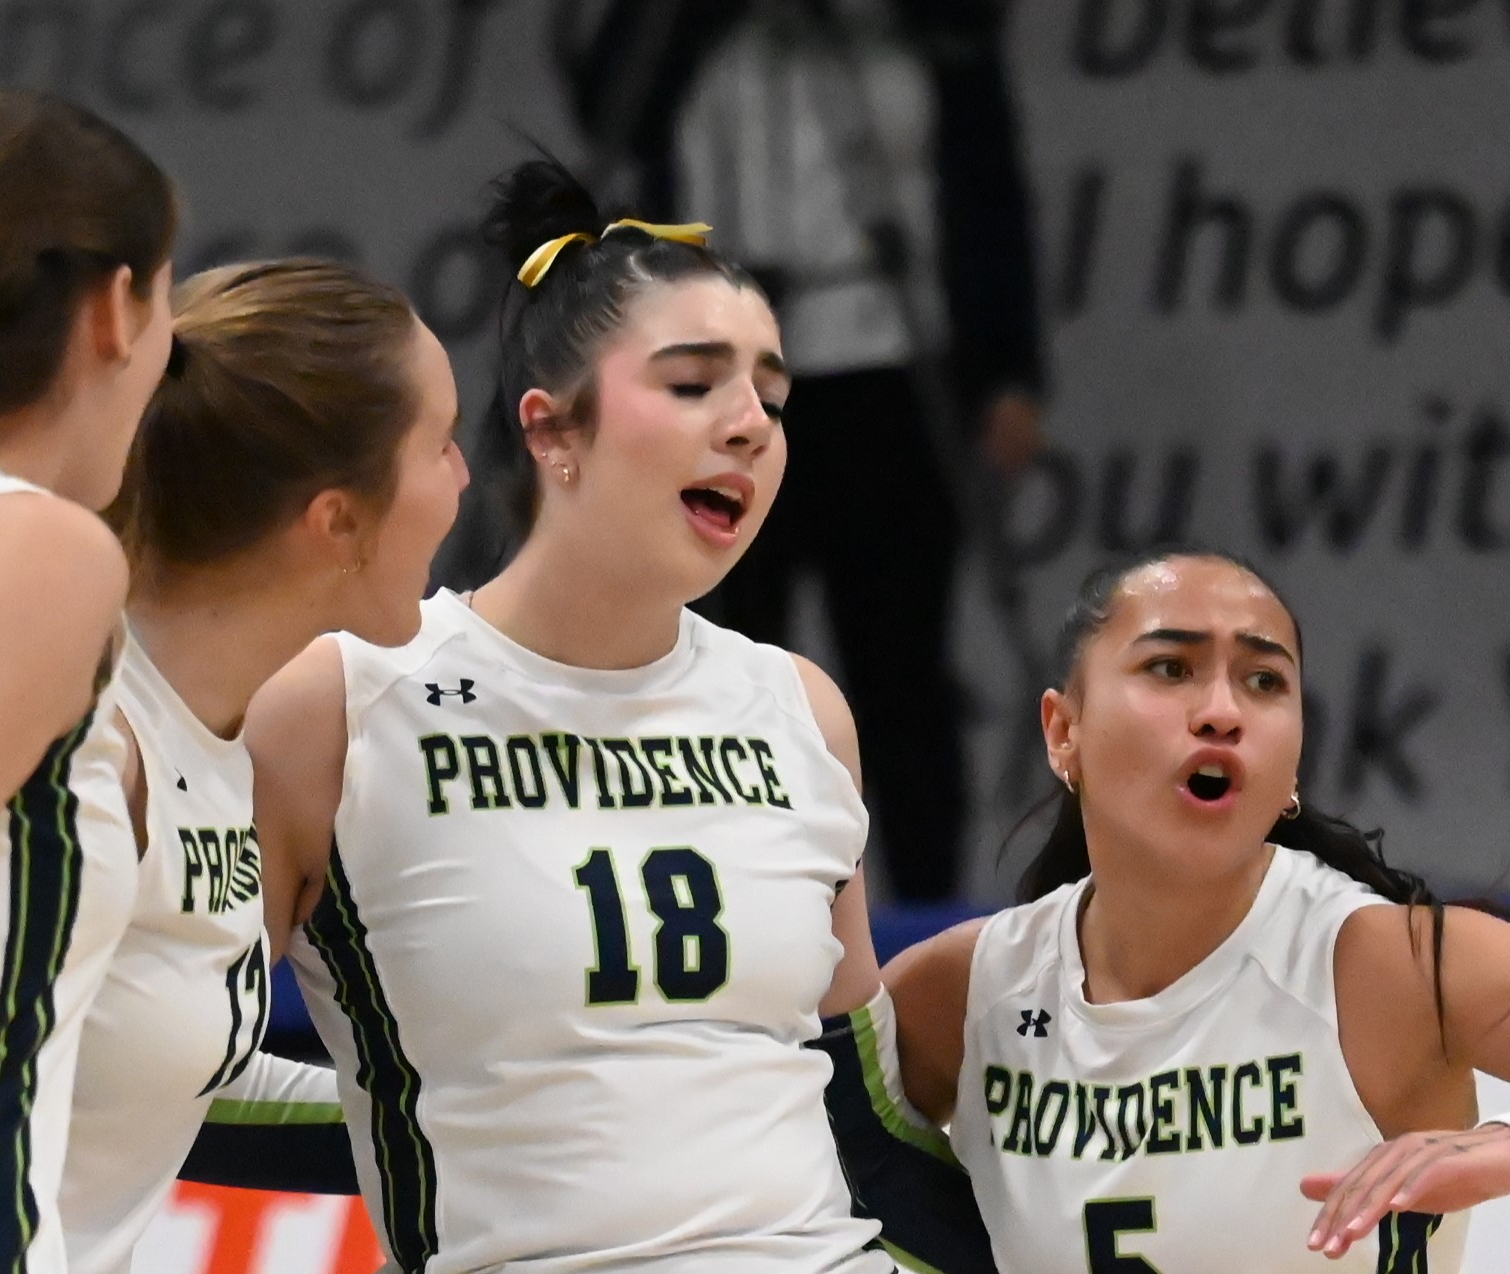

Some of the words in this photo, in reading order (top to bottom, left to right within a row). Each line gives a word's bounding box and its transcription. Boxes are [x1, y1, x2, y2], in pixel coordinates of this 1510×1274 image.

[417, 731, 796, 818] PROVIDENCE
[571, 844, 731, 1008] 18
[984, 1051, 1306, 1164] PROVIDENCE
